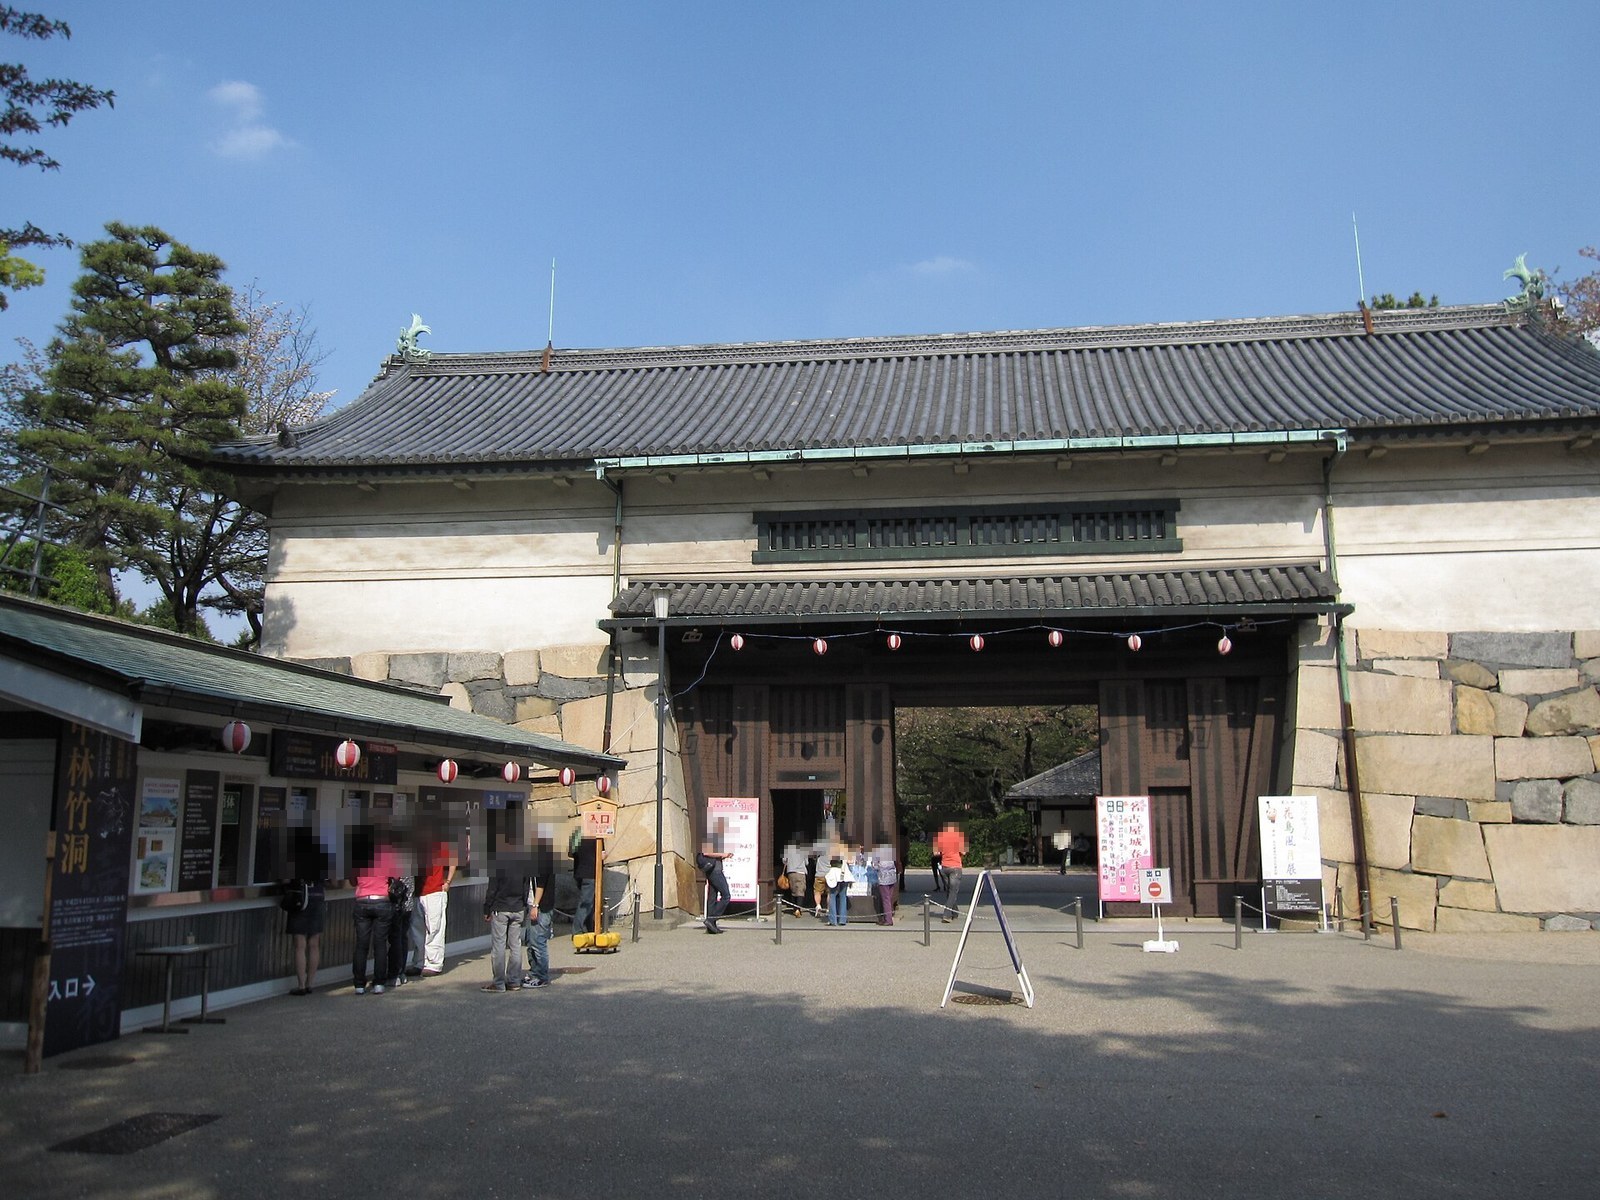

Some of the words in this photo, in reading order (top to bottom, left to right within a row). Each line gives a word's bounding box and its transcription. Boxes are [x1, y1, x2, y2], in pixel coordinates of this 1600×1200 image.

[321, 750, 369, 779] 中洞
[590, 814, 610, 824] 入口
[1146, 870, 1162, 878] 出口
[48, 977, 79, 1001] 入口
